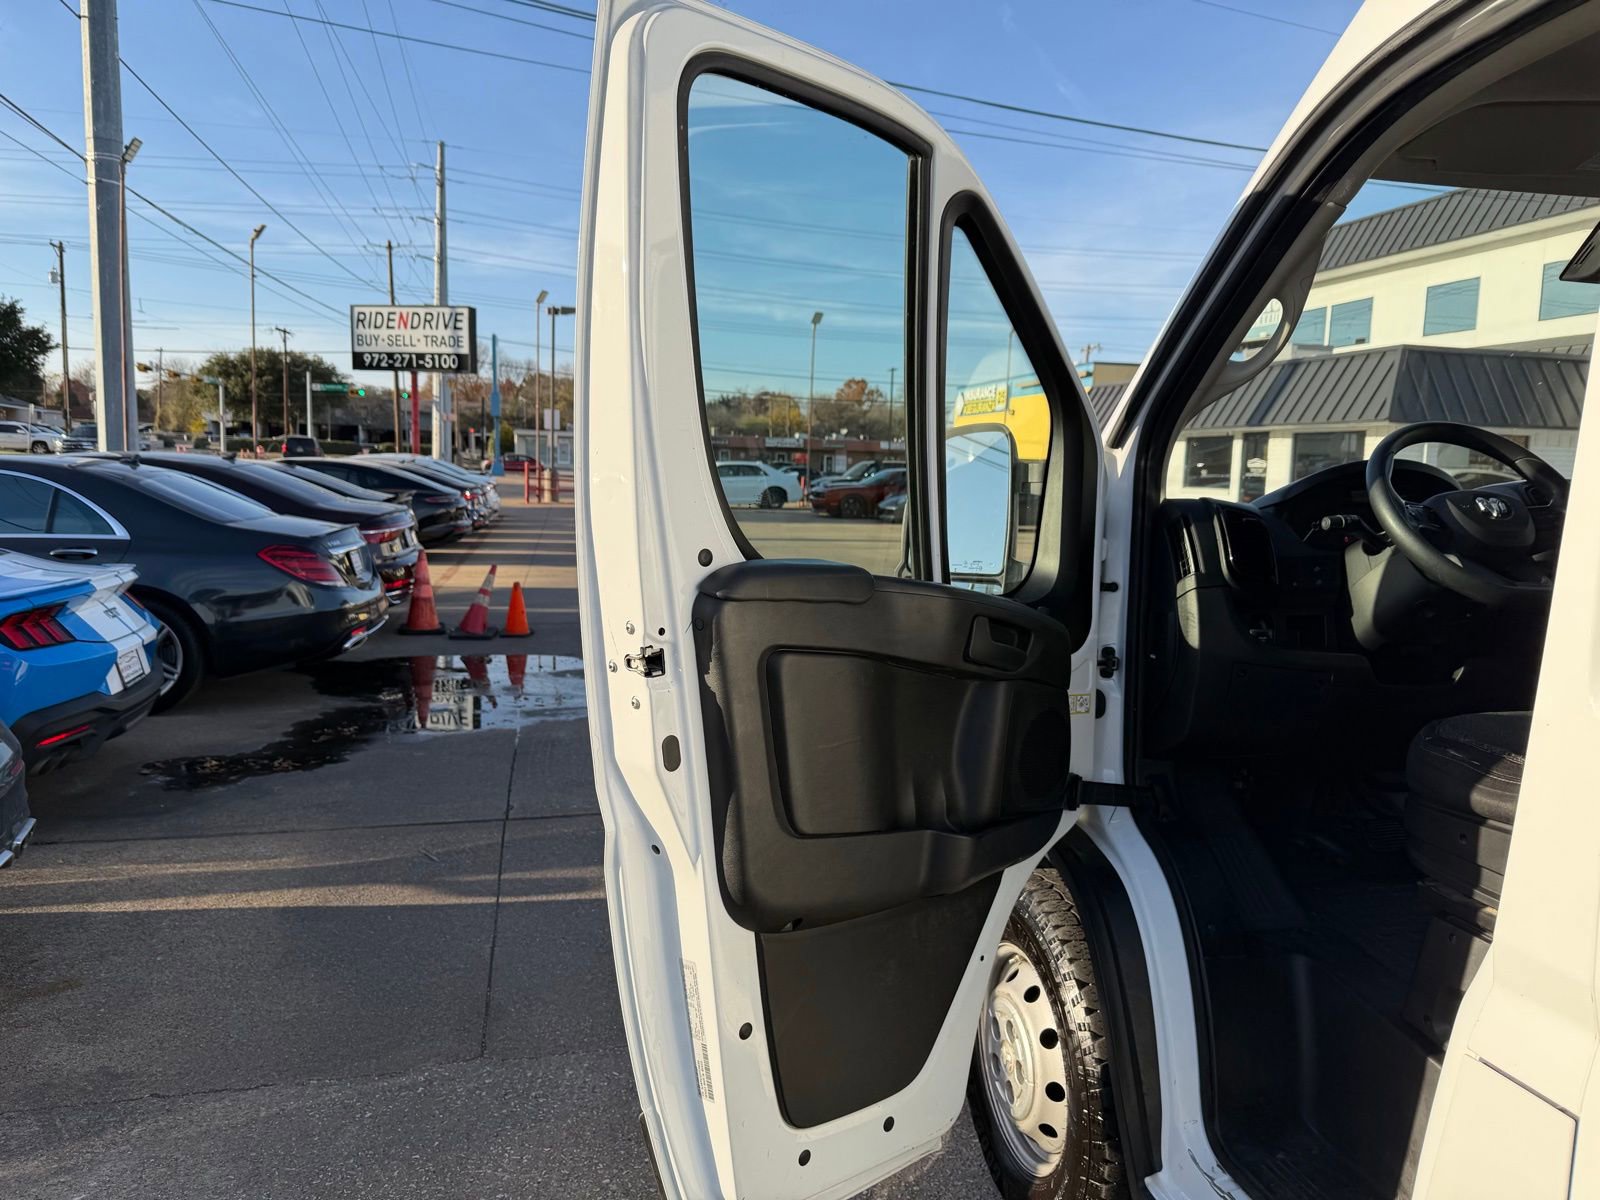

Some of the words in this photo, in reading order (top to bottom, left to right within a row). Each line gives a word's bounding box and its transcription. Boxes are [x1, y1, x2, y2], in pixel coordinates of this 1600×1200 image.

[356, 311, 464, 331] RIDENDRIVE
[356, 334, 381, 347] BUY
[387, 334, 417, 348] SELL
[423, 335, 465, 348] TRADE
[363, 353, 459, 369] 972-271-5100
